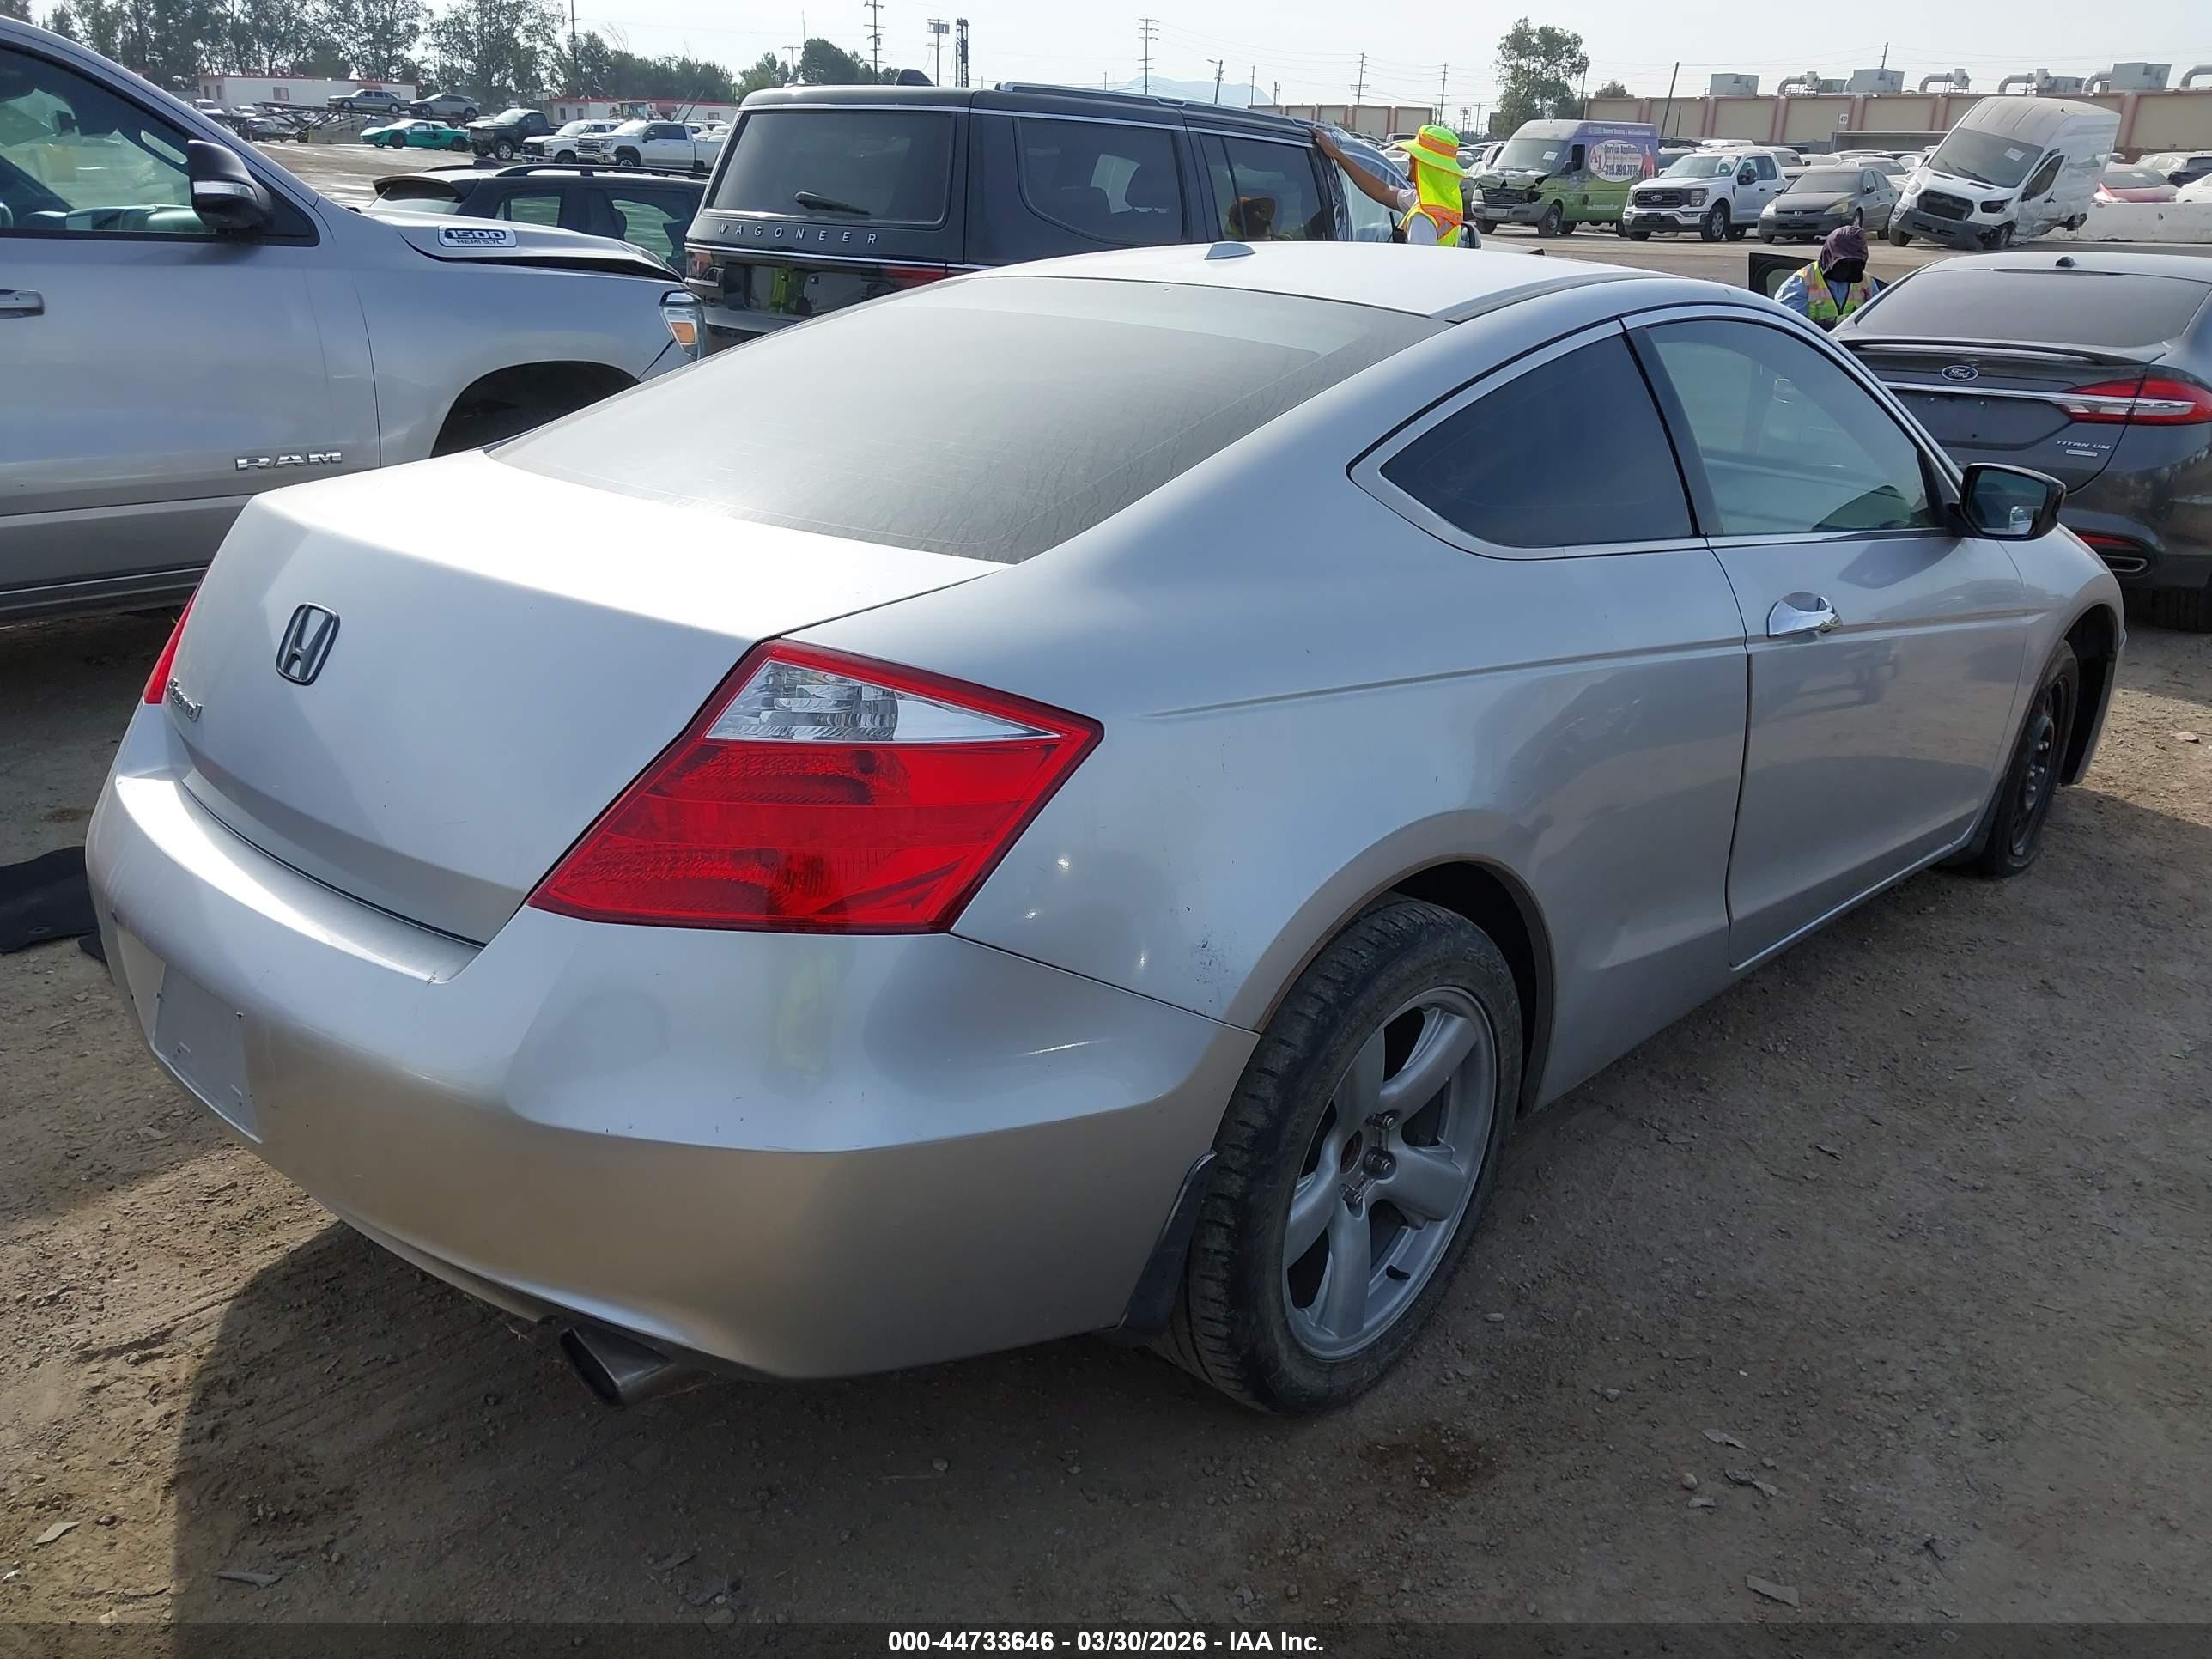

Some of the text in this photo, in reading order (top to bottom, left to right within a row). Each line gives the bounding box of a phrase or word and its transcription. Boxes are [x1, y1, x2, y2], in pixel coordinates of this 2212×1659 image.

[446, 229, 505, 239] 1500
[717, 222, 877, 245] WAGONEER
[1948, 368, 1971, 378] Ford
[235, 452, 343, 470] RAM
